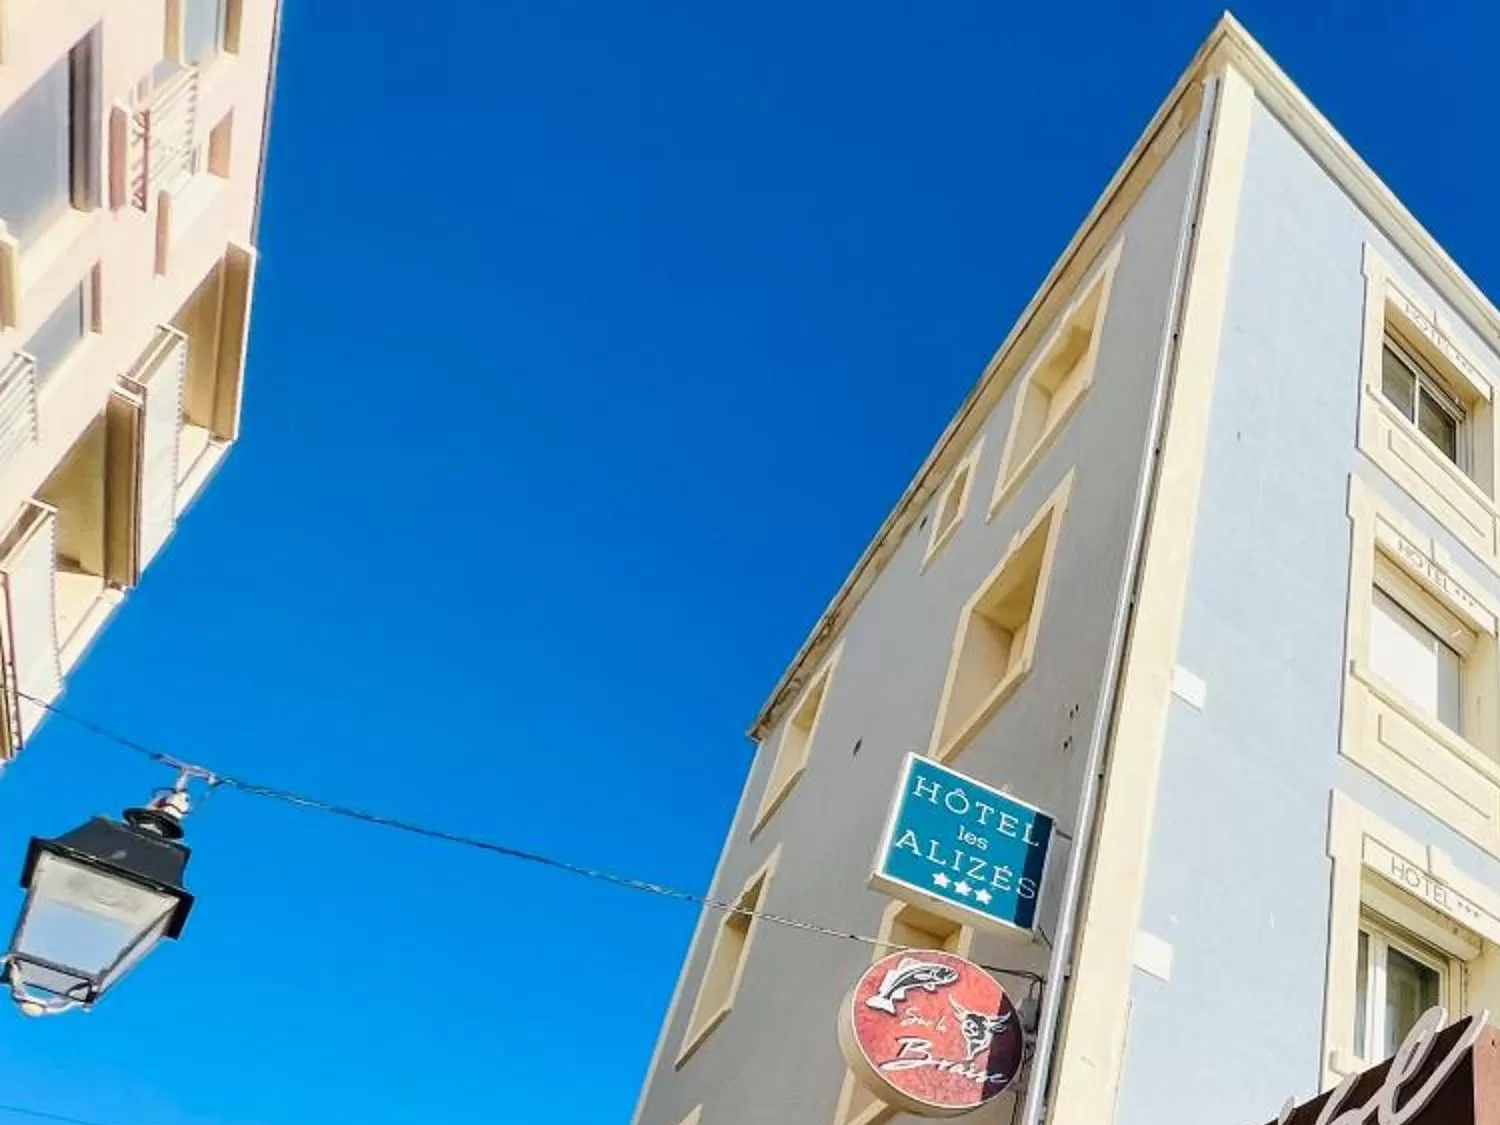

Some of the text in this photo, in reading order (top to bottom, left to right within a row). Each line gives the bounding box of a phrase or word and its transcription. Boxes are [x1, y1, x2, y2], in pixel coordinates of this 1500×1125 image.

[913, 775, 1039, 847] HÔTEL
[956, 824, 989, 850] les
[896, 829, 1036, 899] ALIZÉS
